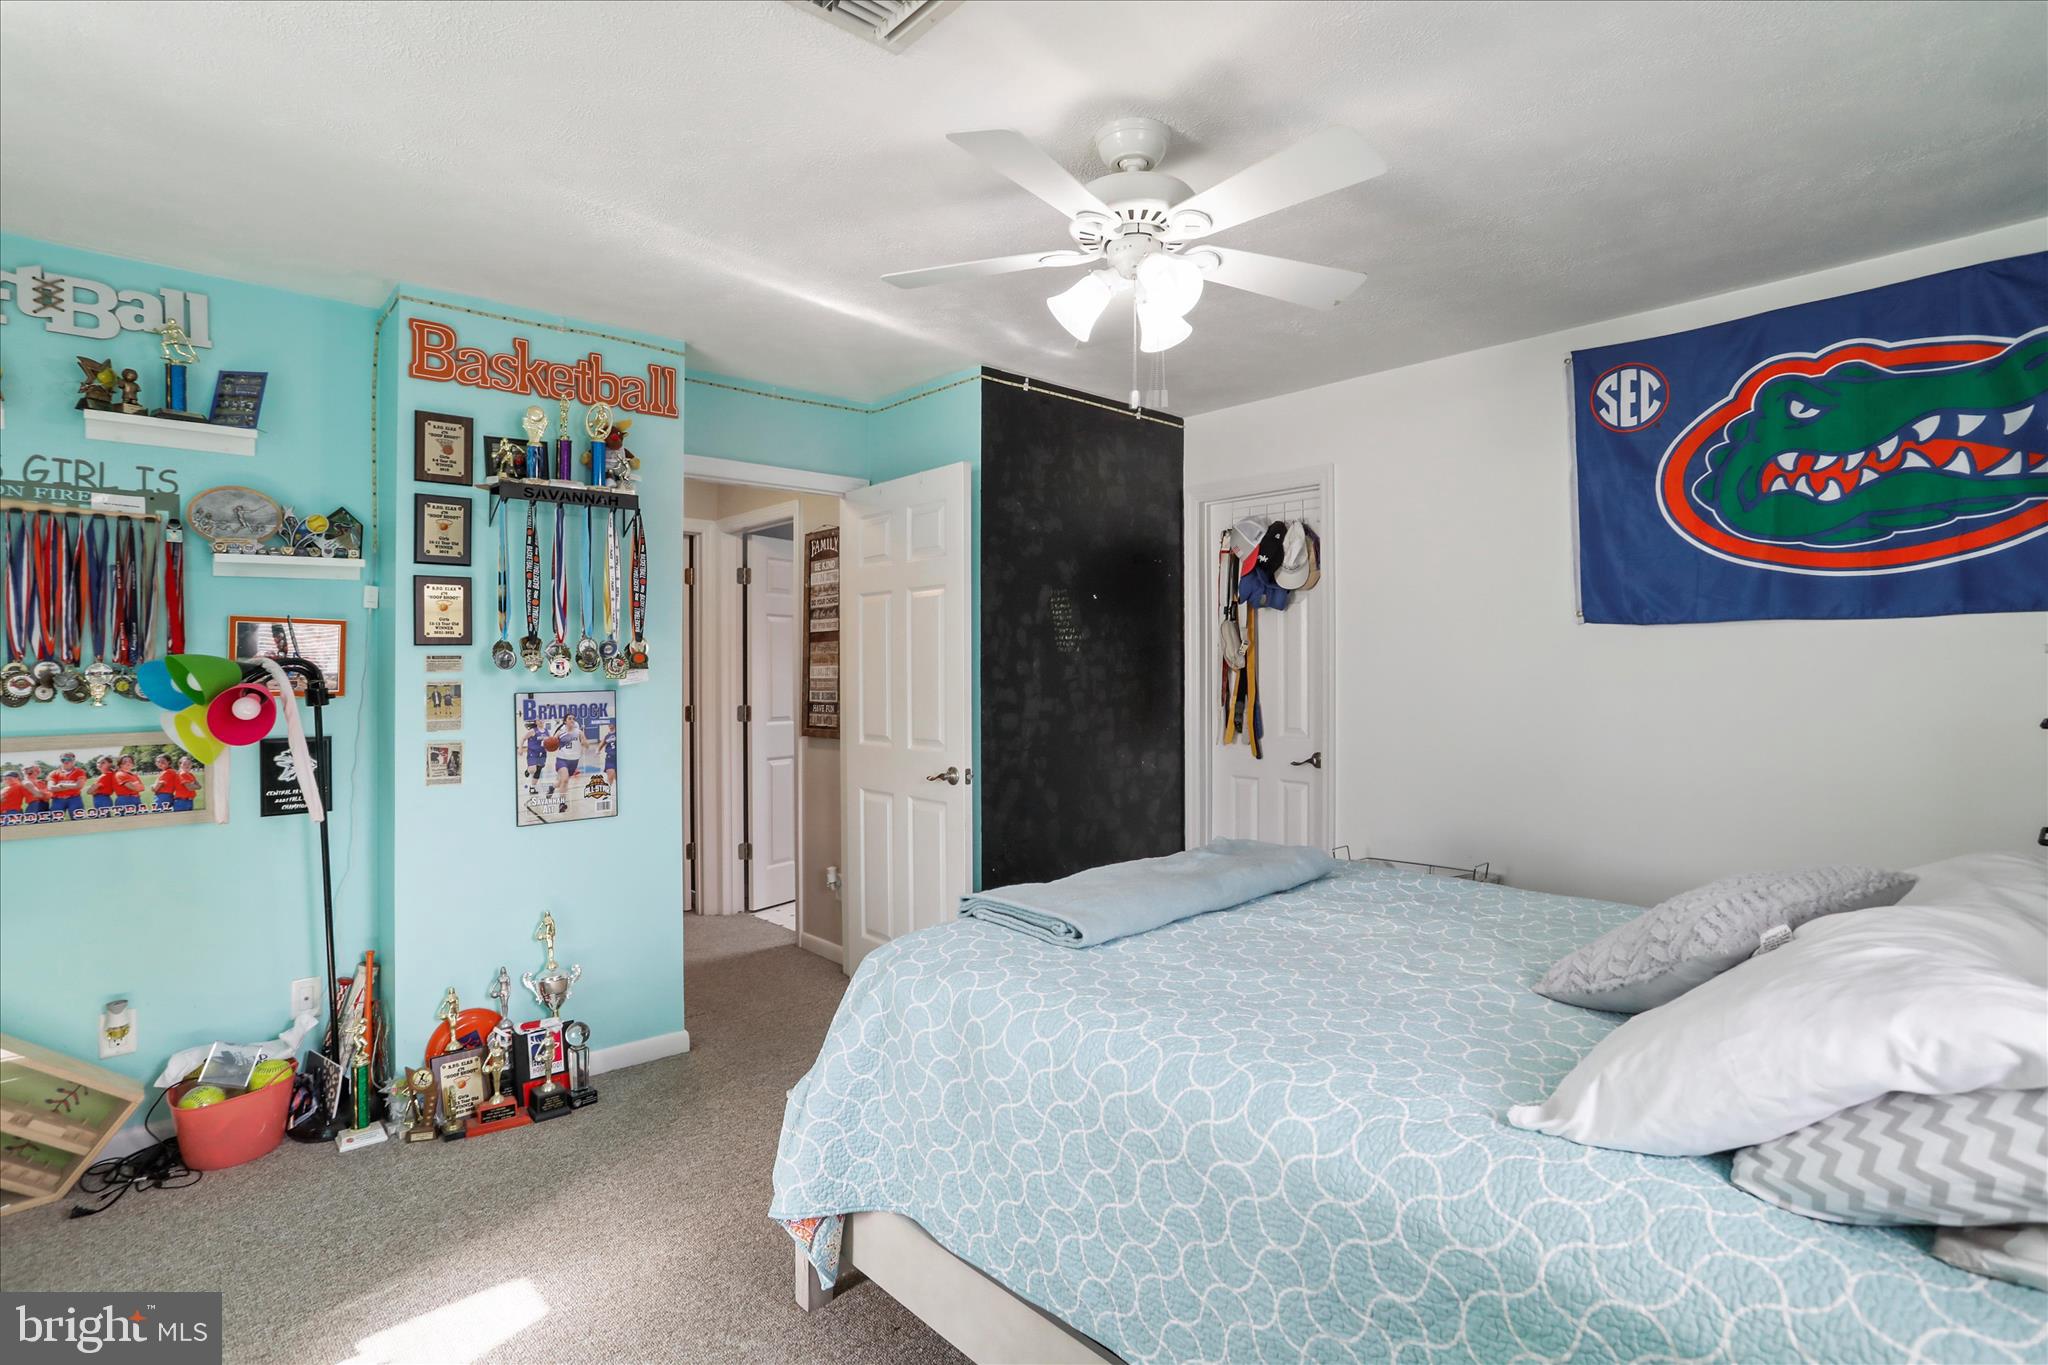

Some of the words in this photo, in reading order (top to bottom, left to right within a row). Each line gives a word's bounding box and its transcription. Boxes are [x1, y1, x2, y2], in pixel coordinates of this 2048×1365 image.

[408, 318, 679, 419] Basketball
[1597, 368, 1661, 427] SEC
[22, 454, 119, 488] GIRL
[136, 466, 179, 494] IS
[34, 487, 91, 502] FIRE
[523, 487, 619, 506] SAVANNAH
[811, 536, 838, 558] FAMILY
[814, 562, 821, 571] BE
[822, 560, 836, 570] KIND
[523, 699, 608, 720] BRADDOCK
[73, 802, 174, 820] SOFTBALL
